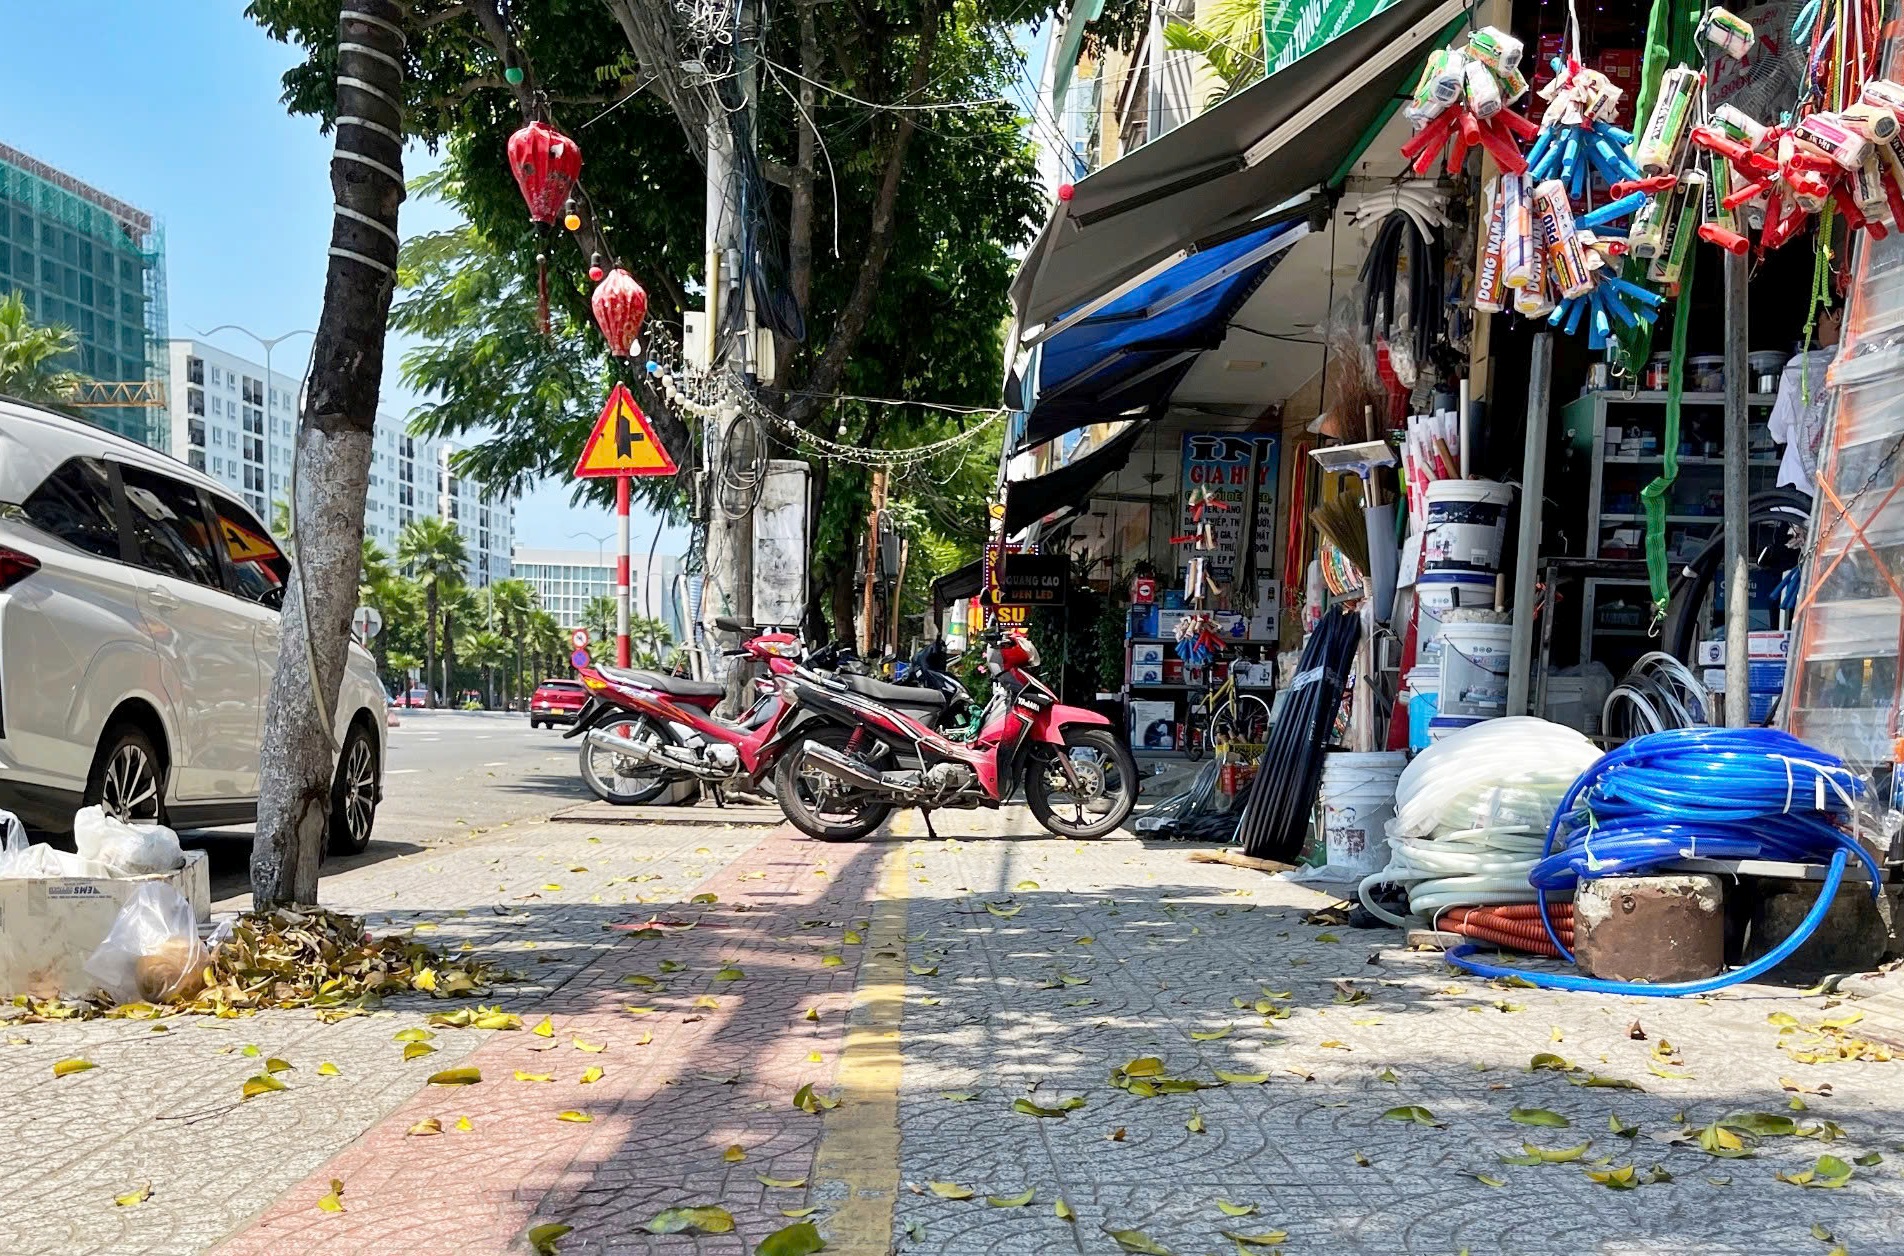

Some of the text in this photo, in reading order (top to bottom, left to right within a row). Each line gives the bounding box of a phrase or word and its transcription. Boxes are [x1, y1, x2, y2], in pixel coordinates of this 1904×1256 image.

[1487, 221, 1503, 255] NAM
[1542, 214, 1559, 245] PRO
[1478, 257, 1497, 301] DONG
[1190, 465, 1225, 485] GIA
